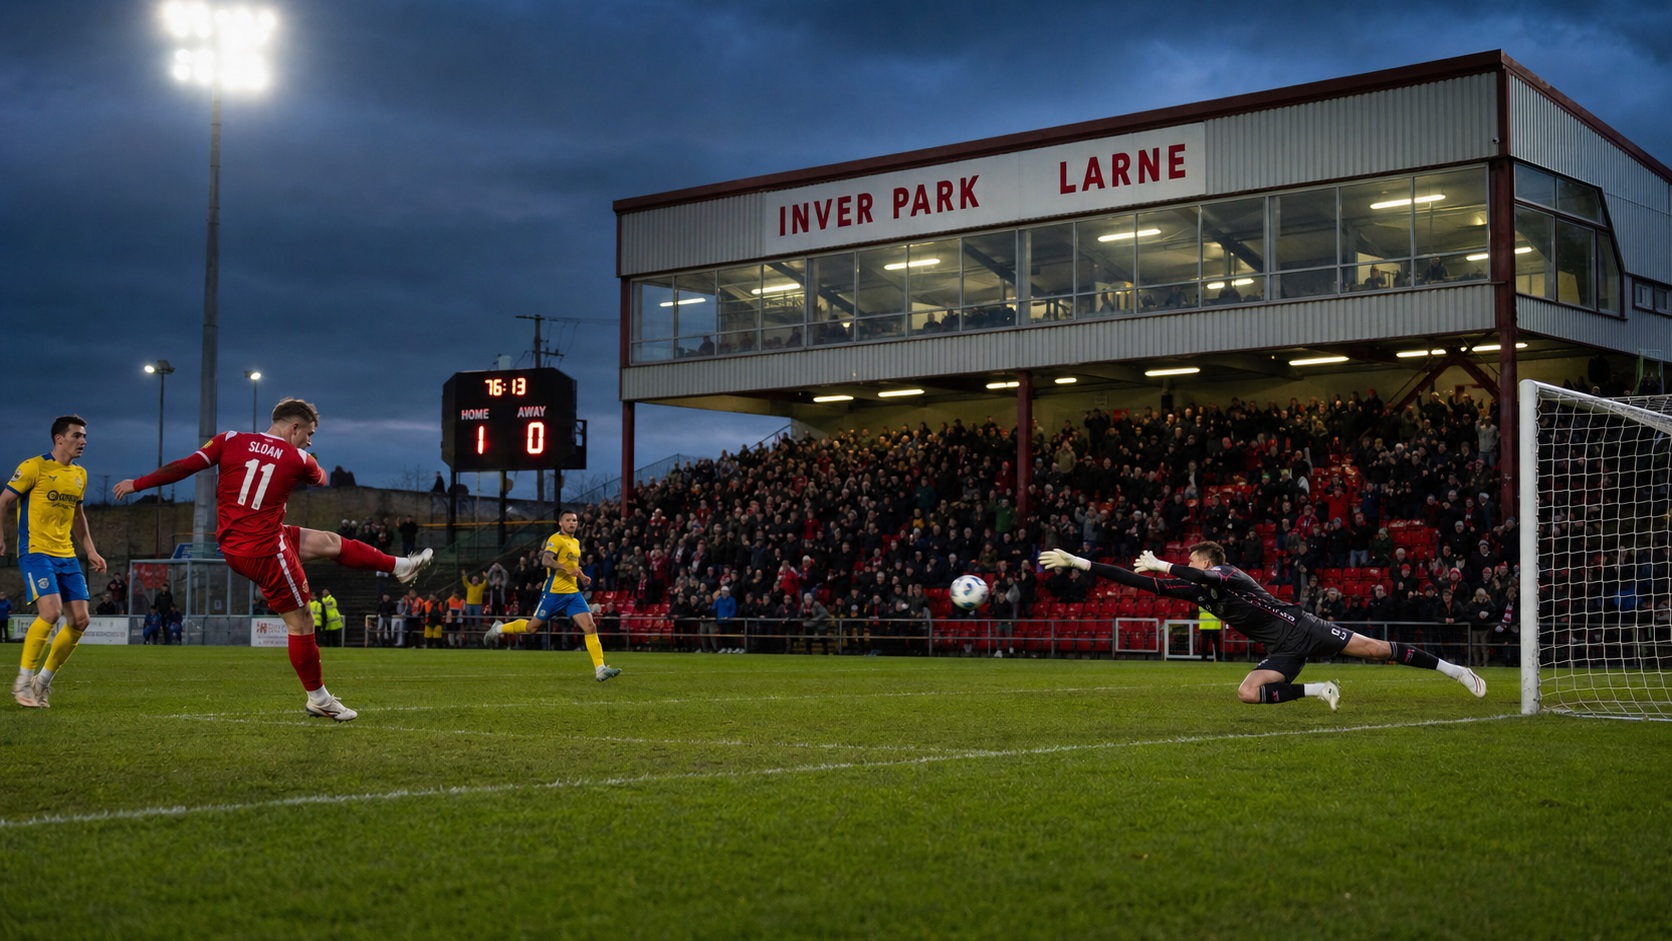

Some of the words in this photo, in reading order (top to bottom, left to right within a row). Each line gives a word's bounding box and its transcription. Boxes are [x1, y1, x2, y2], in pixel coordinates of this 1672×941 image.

[779, 192, 874, 236] INVER
[892, 175, 980, 219] PARK
[1059, 143, 1187, 195] LARNE
[485, 377, 526, 396] 76:13
[461, 408, 490, 420] HOME
[517, 405, 547, 418] AWAY
[248, 441, 283, 460] SLOAN
[477, 425, 485, 454] 1
[527, 421, 545, 454] 0
[237, 458, 276, 511] 11
